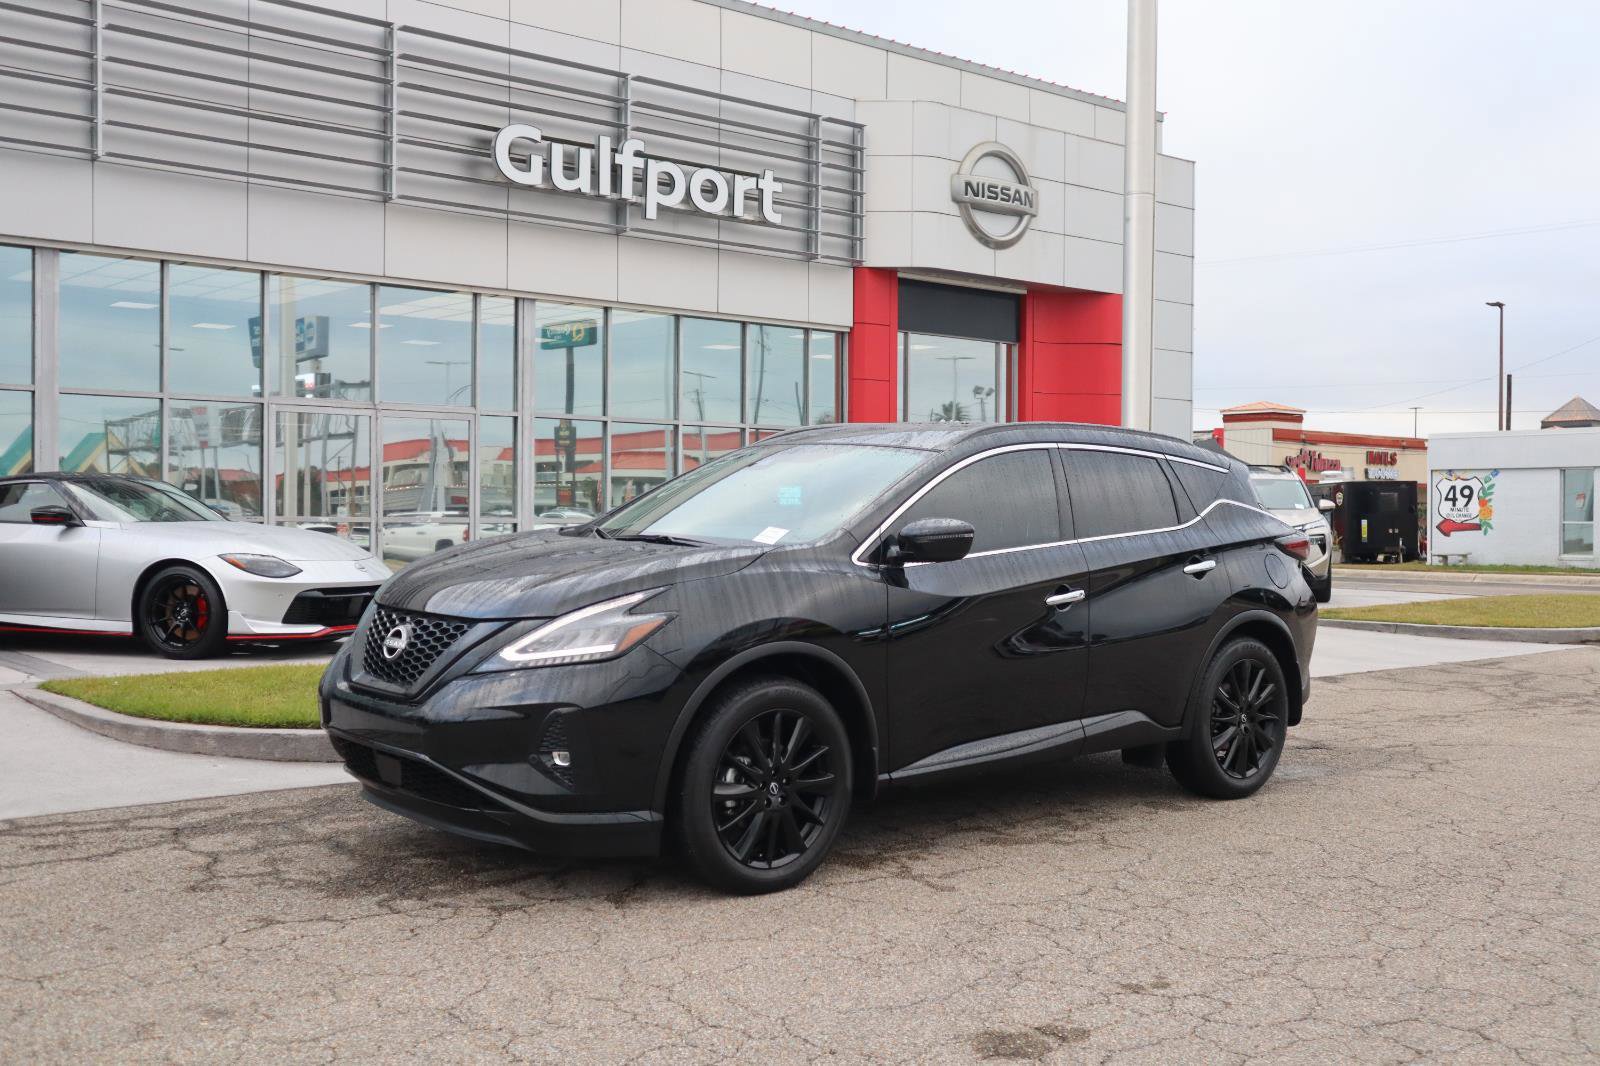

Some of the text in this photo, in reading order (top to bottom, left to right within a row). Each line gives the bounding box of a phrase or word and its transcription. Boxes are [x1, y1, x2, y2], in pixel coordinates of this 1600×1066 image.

[493, 124, 783, 224] Gulfport
[964, 180, 1034, 208] NISSAN
[1366, 451, 1398, 466] NAILS
[1444, 485, 1474, 507] 49
